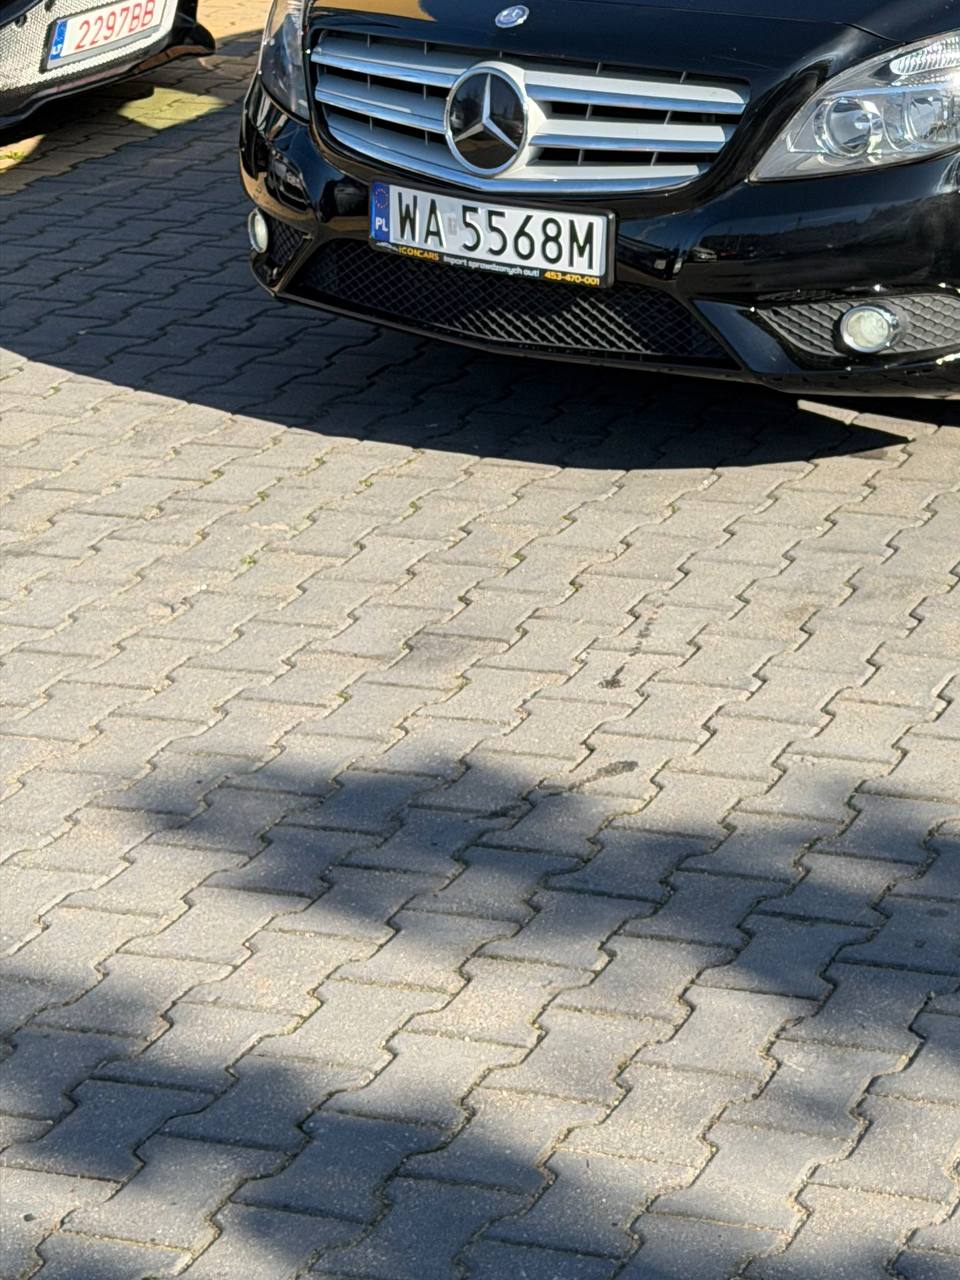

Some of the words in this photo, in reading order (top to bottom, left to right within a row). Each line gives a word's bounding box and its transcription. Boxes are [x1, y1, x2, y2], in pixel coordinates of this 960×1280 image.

[375, 216, 389, 232] PL
[398, 191, 445, 247] WA
[462, 204, 594, 270] 5568M
[399, 246, 439, 261] ICONCARS
